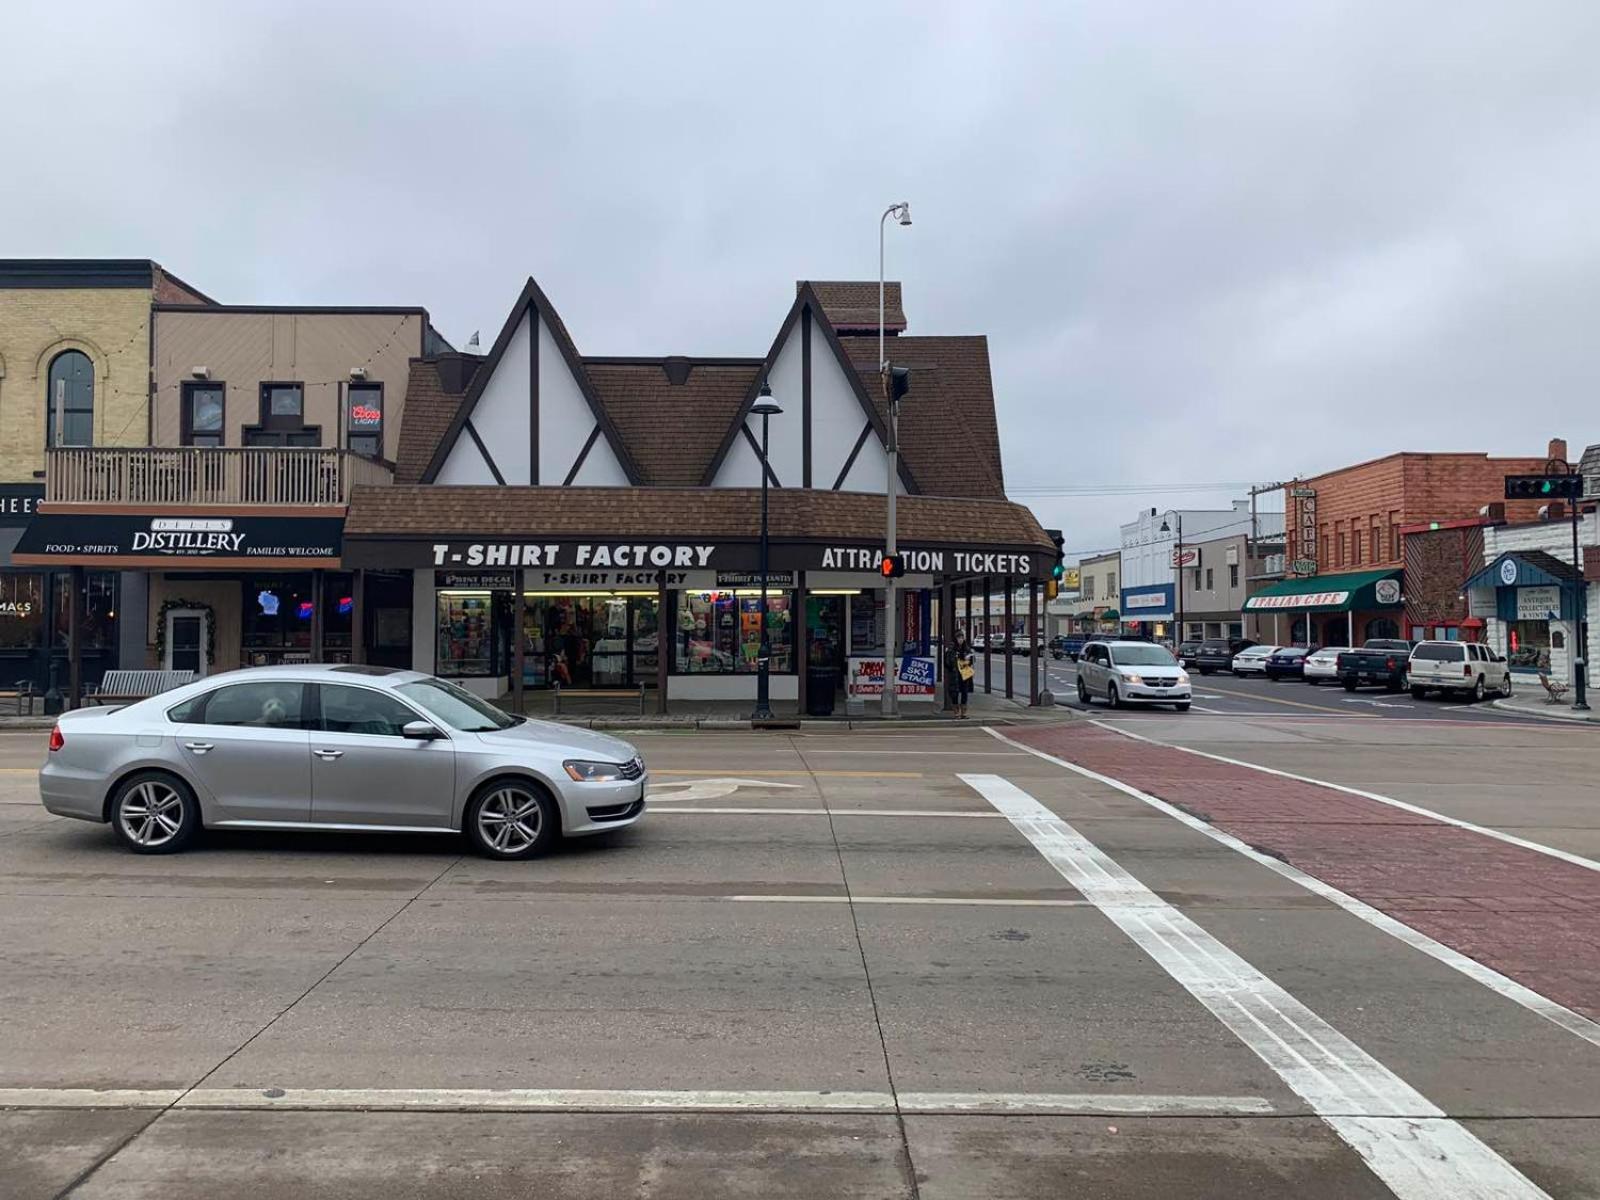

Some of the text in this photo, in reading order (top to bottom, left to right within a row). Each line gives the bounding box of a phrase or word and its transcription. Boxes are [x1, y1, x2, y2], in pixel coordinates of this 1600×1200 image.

[352, 405, 381, 420] Coors
[132, 532, 246, 551] DISTILLERY
[45, 545, 119, 553] FOOD SPIRITS
[246, 547, 334, 555] FAMILIES WELCOME
[433, 545, 715, 566] T-SHIRT FACTORY
[822, 548, 1031, 574] ATTRATION TICKETS
[543, 573, 608, 585] T-SHIRT
[1254, 593, 1340, 607] ITALIAN CAFE
[906, 666, 930, 677] SKY
[901, 672, 933, 685] STAGE
